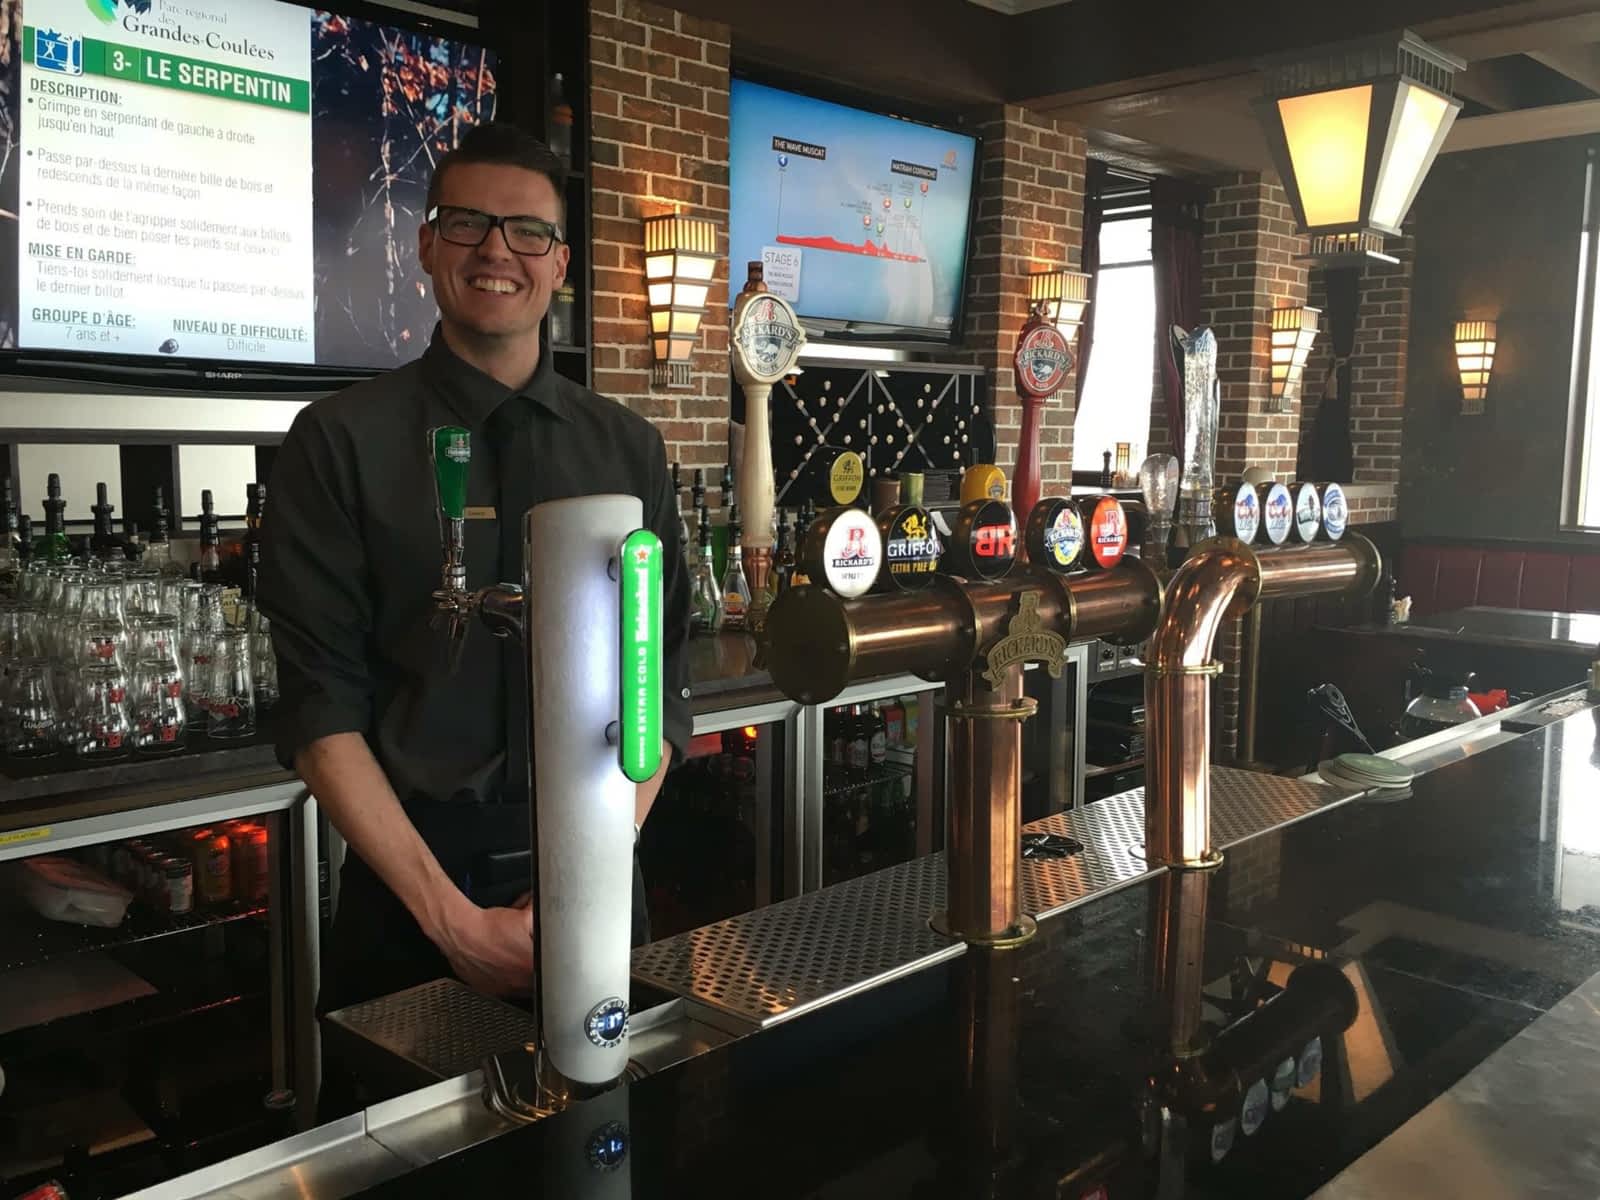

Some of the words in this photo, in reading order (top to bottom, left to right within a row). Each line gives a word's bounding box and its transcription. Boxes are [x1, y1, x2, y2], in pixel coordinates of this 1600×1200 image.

[158, 13, 176, 26] des
[185, 7, 228, 25] régional
[112, 51, 133, 72] 3-
[146, 55, 171, 82] LE
[178, 61, 292, 104] SERPENTIN
[30, 78, 123, 106] DESCRIPTION:
[38, 97, 81, 117] Grimpe
[83, 106, 97, 119] en
[101, 109, 158, 129] serpentant
[160, 117, 175, 132] de
[176, 121, 215, 139] gauche
[225, 129, 256, 145] droite
[38, 113, 87, 133] jusqu'en
[89, 122, 115, 138] haut
[774, 138, 786, 150] THE
[786, 141, 802, 153] WAVE
[802, 144, 826, 158] MUSCAT
[37, 147, 72, 166] Passe
[140, 162, 150, 177] la
[153, 164, 198, 184] dernière
[200, 170, 223, 188] bille
[225, 175, 238, 190] de
[240, 176, 263, 193] bois
[264, 183, 274, 194] et
[37, 167, 103, 187] redescends
[105, 175, 120, 189] de
[123, 176, 133, 191] la
[136, 181, 169, 195] même
[171, 182, 201, 201] façon
[37, 198, 78, 217] Prends
[81, 206, 106, 219] soin
[109, 207, 123, 222] de
[180, 215, 238, 237] solidement
[36, 216, 51, 231] de
[54, 219, 79, 233] bois
[82, 223, 93, 235] et
[96, 223, 111, 237] de
[113, 225, 138, 241] bien
[141, 231, 171, 245] poser
[193, 237, 221, 251] pieds
[28, 242, 62, 258] MISE
[66, 246, 84, 260] EN
[88, 248, 136, 266] GARDE:
[764, 251, 792, 266] STAGE
[793, 256, 800, 267] 6
[36, 278, 47, 292] le
[50, 280, 91, 296] dernier
[37, 261, 89, 279] Tiens-toi
[91, 267, 153, 285] solidement
[156, 272, 197, 290] lorsque
[199, 279, 211, 291] tu
[32, 307, 88, 324] GROUPE
[92, 310, 136, 328] D'ÂGE:
[64, 326, 73, 339] 7
[76, 329, 97, 342] ans
[100, 330, 111, 342] et
[173, 319, 218, 334] NIVEAU
[222, 322, 238, 335] DE
[241, 323, 309, 343] DIFFICULTÉ:
[226, 338, 266, 353] Difficile
[204, 371, 243, 380] SHARP
[637, 646, 648, 686] COLD
[637, 687, 648, 735] EXTRA
